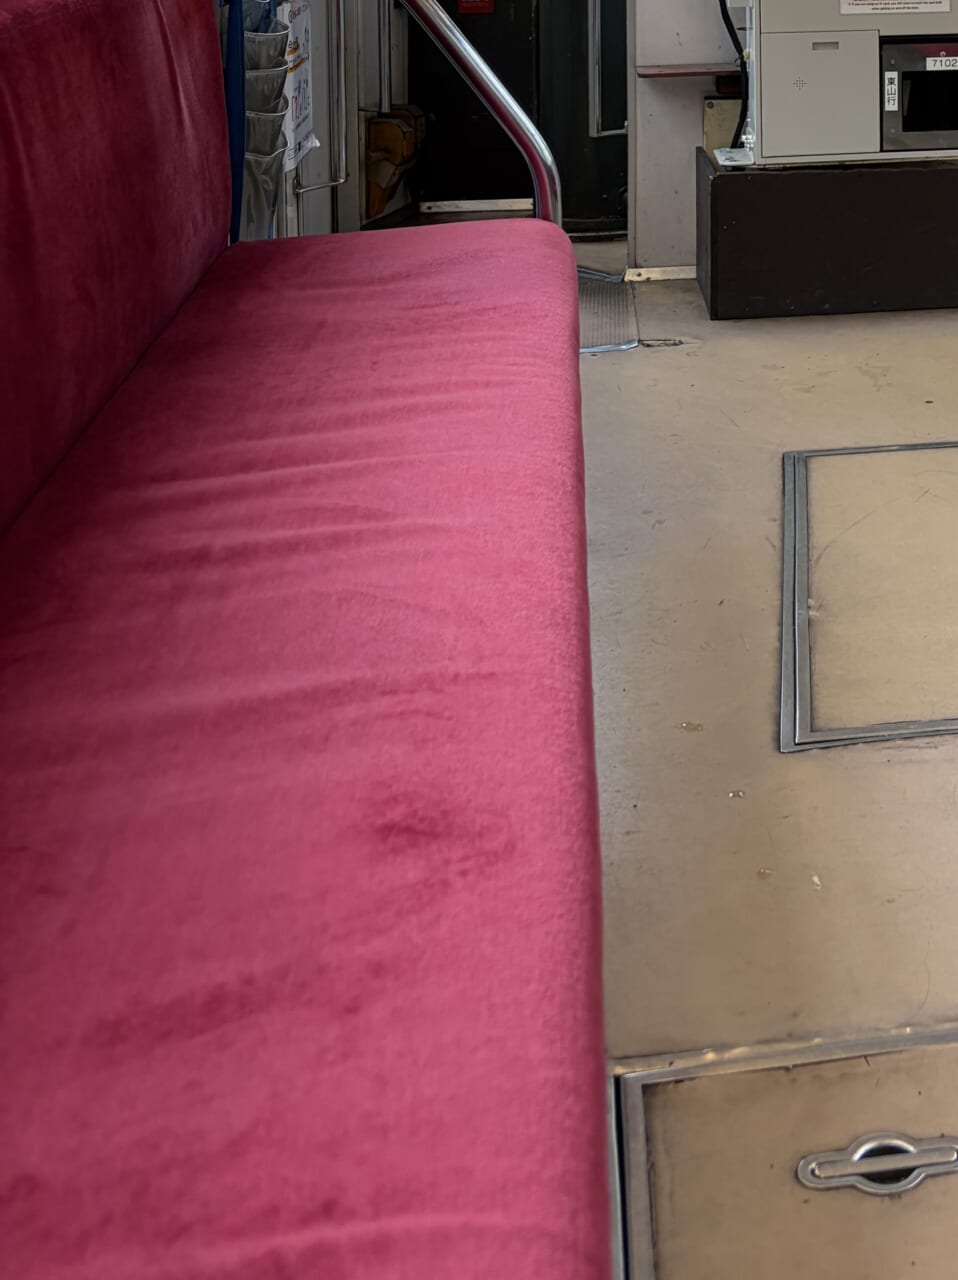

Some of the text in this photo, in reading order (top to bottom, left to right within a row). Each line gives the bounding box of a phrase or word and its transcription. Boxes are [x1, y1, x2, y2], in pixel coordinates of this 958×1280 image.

[931, 59, 958, 68] 7102
[887, 77, 896, 105] 東山行
